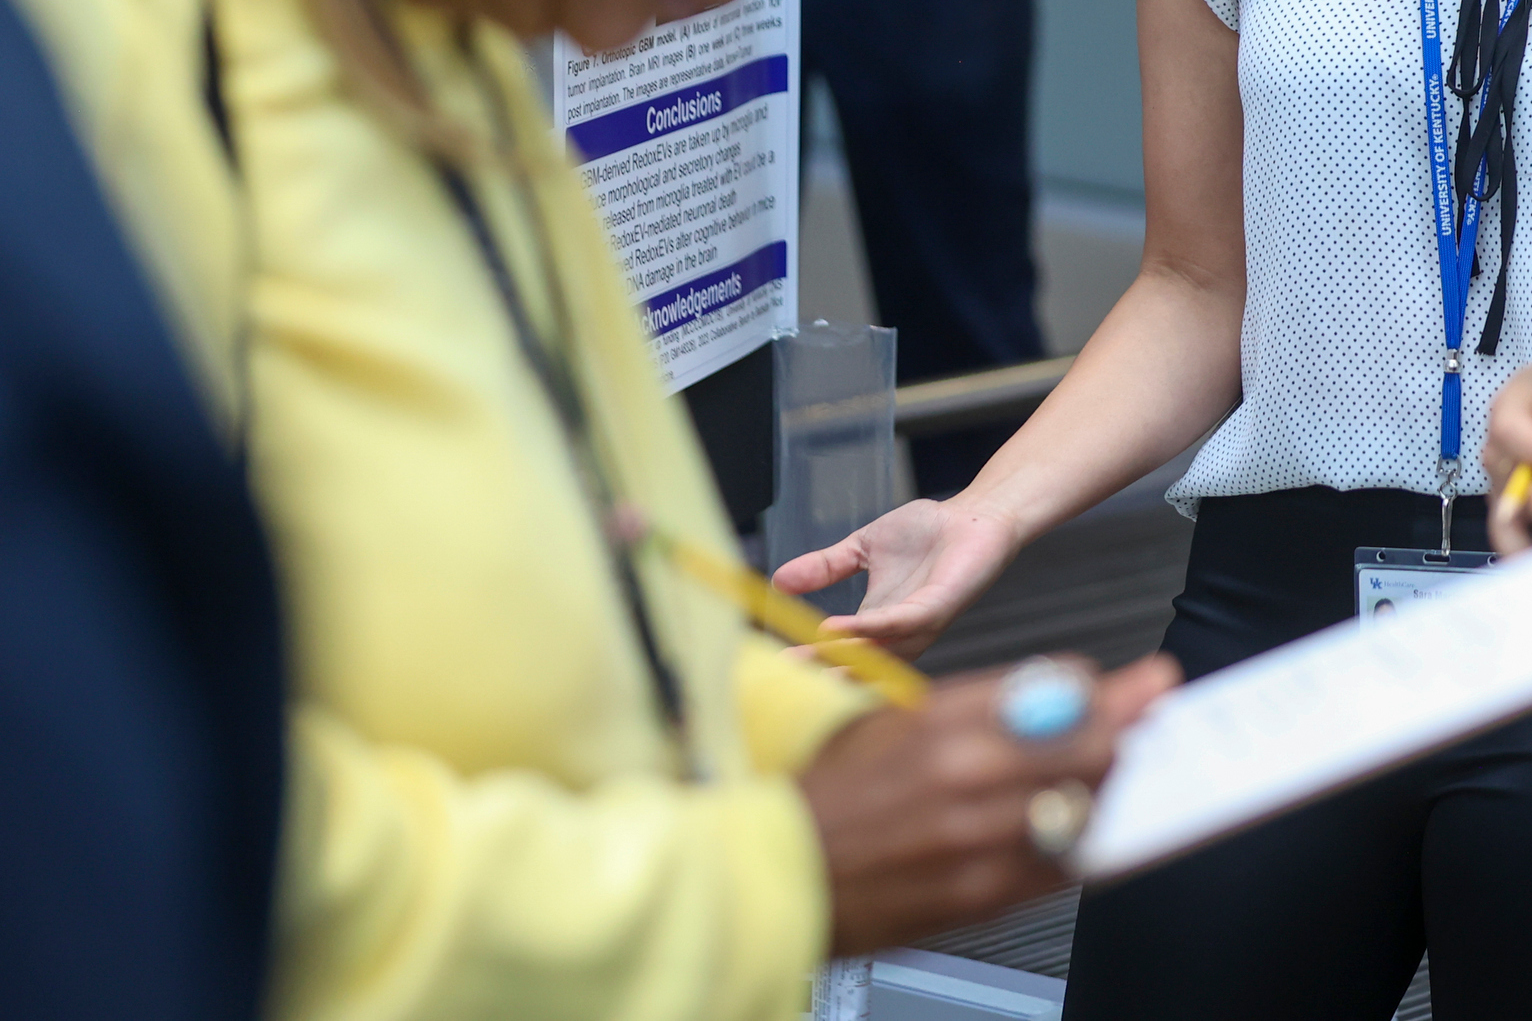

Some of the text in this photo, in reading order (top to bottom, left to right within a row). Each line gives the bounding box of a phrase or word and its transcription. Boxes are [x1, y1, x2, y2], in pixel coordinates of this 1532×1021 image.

[567, 25, 690, 76] Figure 7. Orthotopic GBM model. (A)
[567, 81, 586, 97] tumor
[588, 68, 626, 90] implantation.
[628, 59, 645, 78] Brain
[648, 55, 659, 71] MRI
[662, 49, 683, 67] images
[685, 44, 696, 62] (B)
[698, 40, 710, 55] one
[755, 15, 782, 31] weeks
[567, 104, 582, 122] post
[583, 92, 621, 117] implantation.
[623, 86, 634, 101] The
[636, 78, 657, 98] images
[659, 76, 669, 90] are
[669, 62, 712, 87] representative
[646, 89, 722, 134] Conclusions
[581, 122, 730, 190] GBM-derived RedoxEVs are taken up by
[608, 172, 660, 206] morphological
[663, 167, 677, 184] and
[679, 156, 713, 182] secretory
[715, 142, 741, 166] changes
[1434, 145, 1446, 162] OF
[603, 170, 732, 230] released from microglia treated with
[683, 189, 737, 223] neuronal death
[1435, 164, 1452, 236] UNIVERSITY
[635, 237, 674, 267] RedoxEVs
[675, 233, 692, 252] alter
[693, 217, 727, 244] cognitive
[626, 273, 645, 297] DNA
[645, 263, 675, 288] damage
[676, 257, 683, 273] in
[684, 254, 697, 271] the
[699, 245, 717, 266] brain
[641, 272, 742, 336] cknowledgements
[1384, 581, 1415, 589] HealthCare
[1413, 589, 1432, 600] Sara
